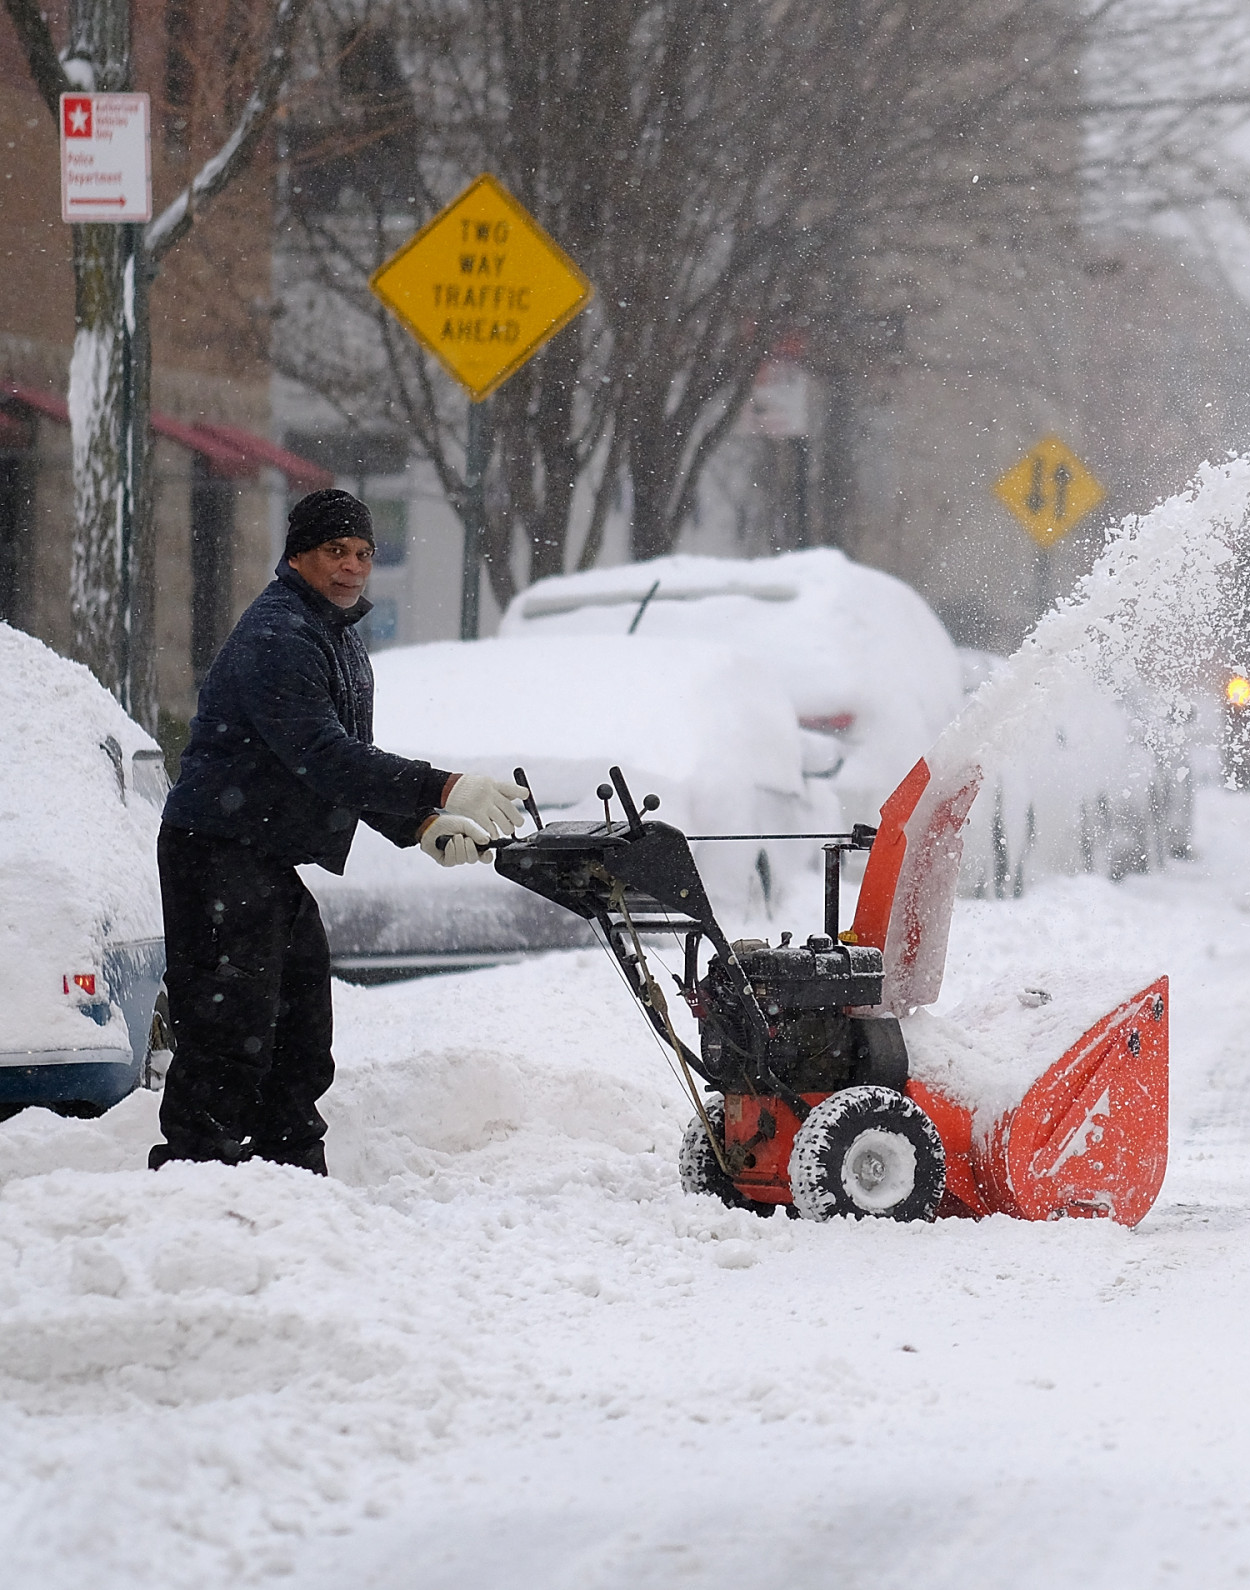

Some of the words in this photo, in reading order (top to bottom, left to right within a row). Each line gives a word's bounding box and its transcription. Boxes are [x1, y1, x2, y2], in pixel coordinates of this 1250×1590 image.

[68, 153, 94, 165] Police
[68, 172, 122, 186] Department
[460, 219, 509, 244] TWO
[459, 254, 505, 275] WAY
[432, 284, 531, 311] TRAFFIC
[441, 319, 520, 344] AHEAD
